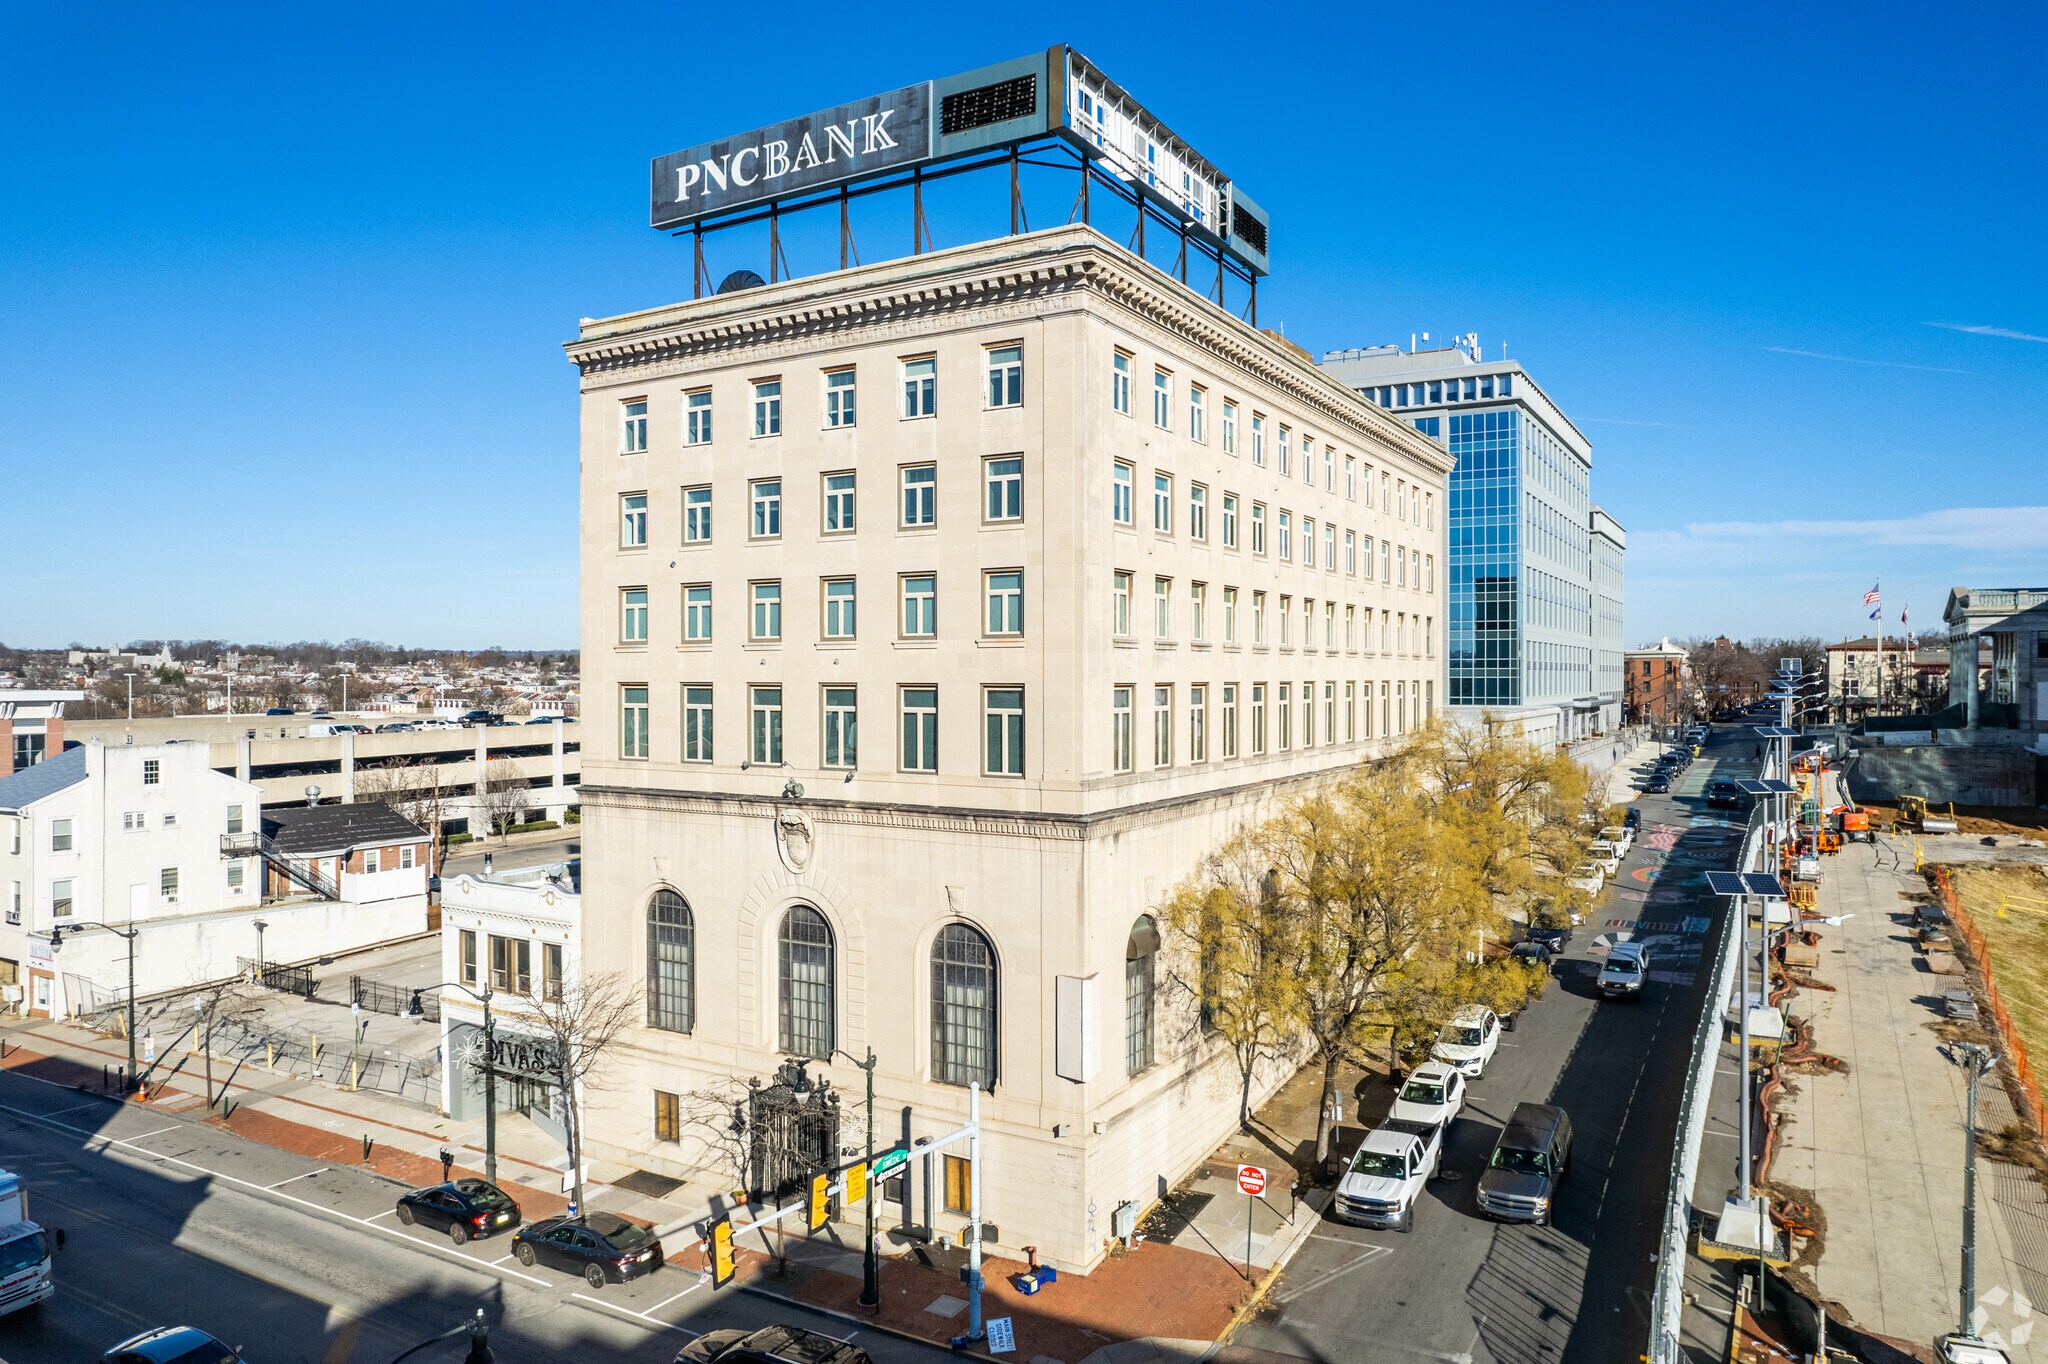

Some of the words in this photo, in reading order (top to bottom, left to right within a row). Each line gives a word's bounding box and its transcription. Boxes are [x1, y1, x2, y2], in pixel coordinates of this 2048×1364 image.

[882, 1154, 901, 1169] SWEDE
[891, 1166, 901, 1174] WAY
[988, 1327, 997, 1347] CLOSED
[996, 1323, 1005, 1348] SIDEWALK
[1005, 1333, 1013, 1349] STREET
